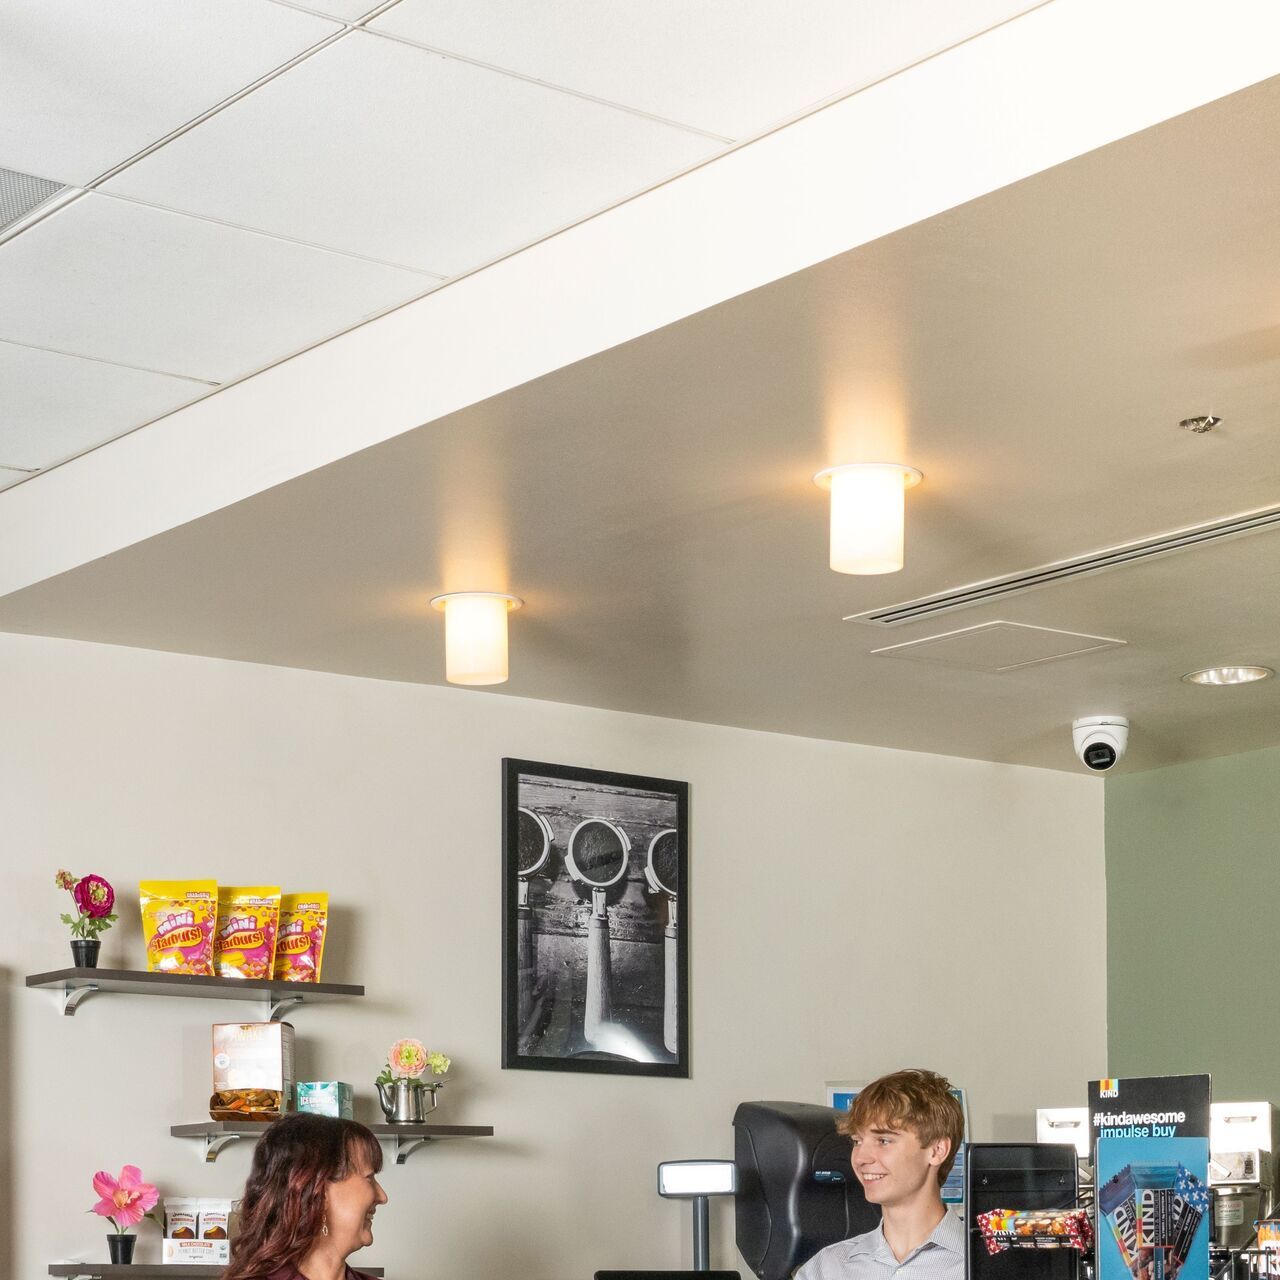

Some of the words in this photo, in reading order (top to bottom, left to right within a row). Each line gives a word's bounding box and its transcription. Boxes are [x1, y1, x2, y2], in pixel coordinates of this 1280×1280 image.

[1100, 1089, 1119, 1099] KIND
[1093, 1109, 1185, 1126] #kindawesome
[1100, 1125, 1148, 1138] impulse
[1152, 1124, 1175, 1138] buy
[1141, 1189, 1154, 1247] KIND
[1114, 1206, 1138, 1261] KIND
